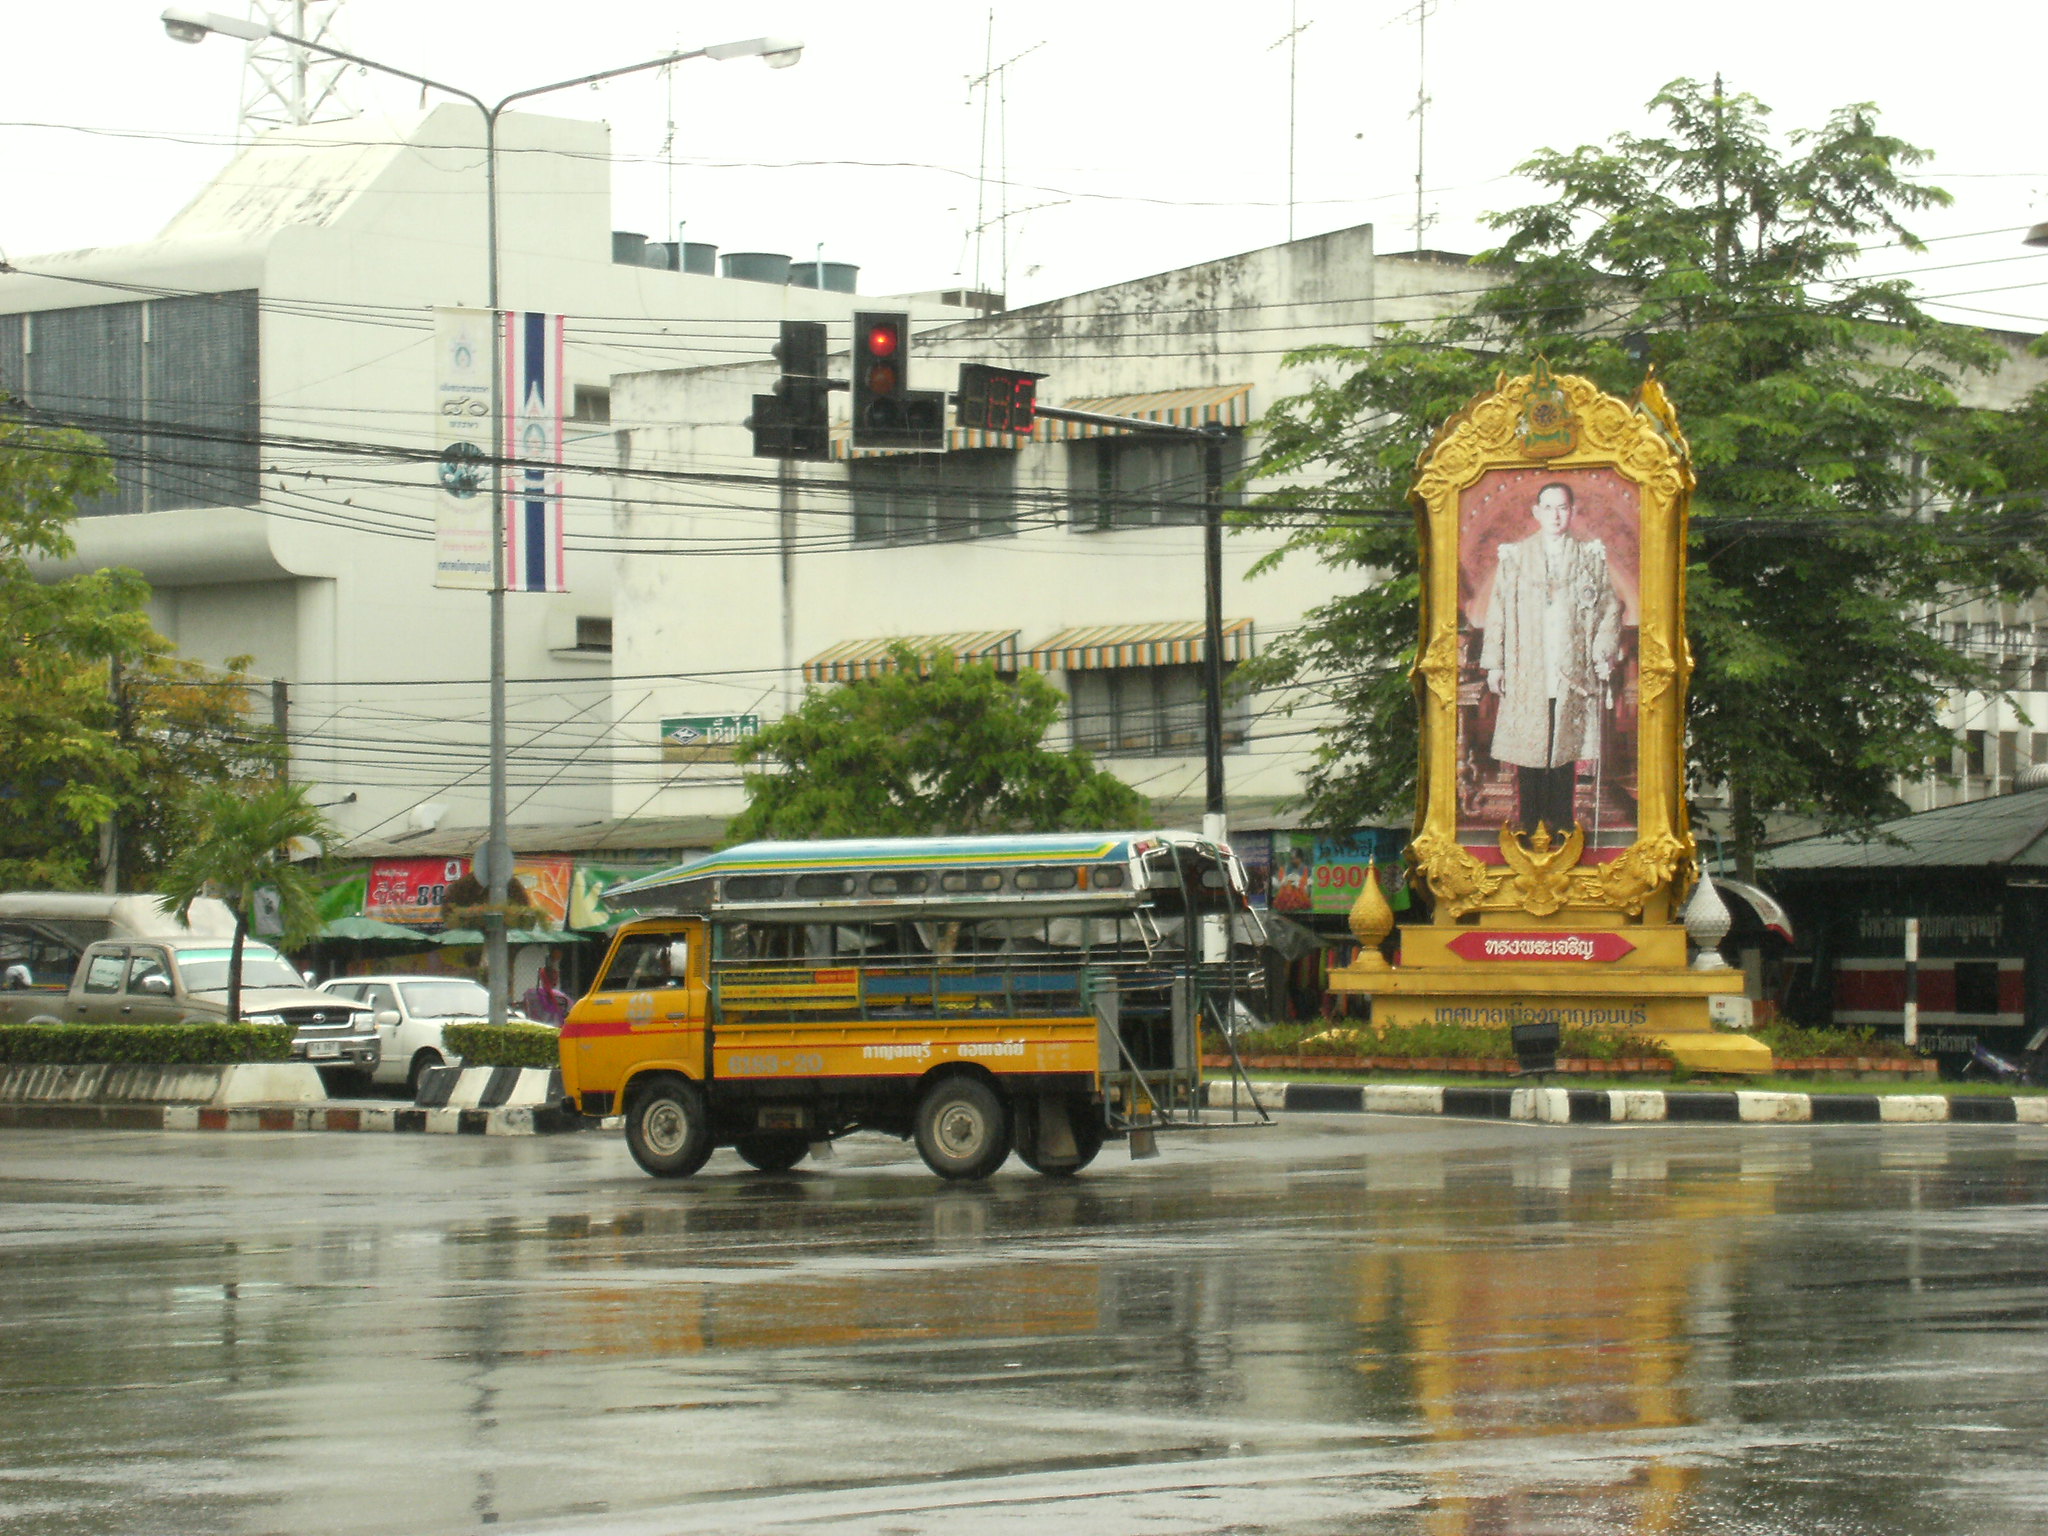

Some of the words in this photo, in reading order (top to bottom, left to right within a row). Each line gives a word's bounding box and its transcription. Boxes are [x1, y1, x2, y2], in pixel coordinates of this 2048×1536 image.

[1484, 936, 1595, 961] ทรงพระเจริญ
[1434, 1002, 1648, 1028] เทศบาลเมืองกาญจนบุรี
[862, 1040, 932, 1064] กาญจนบุรี
